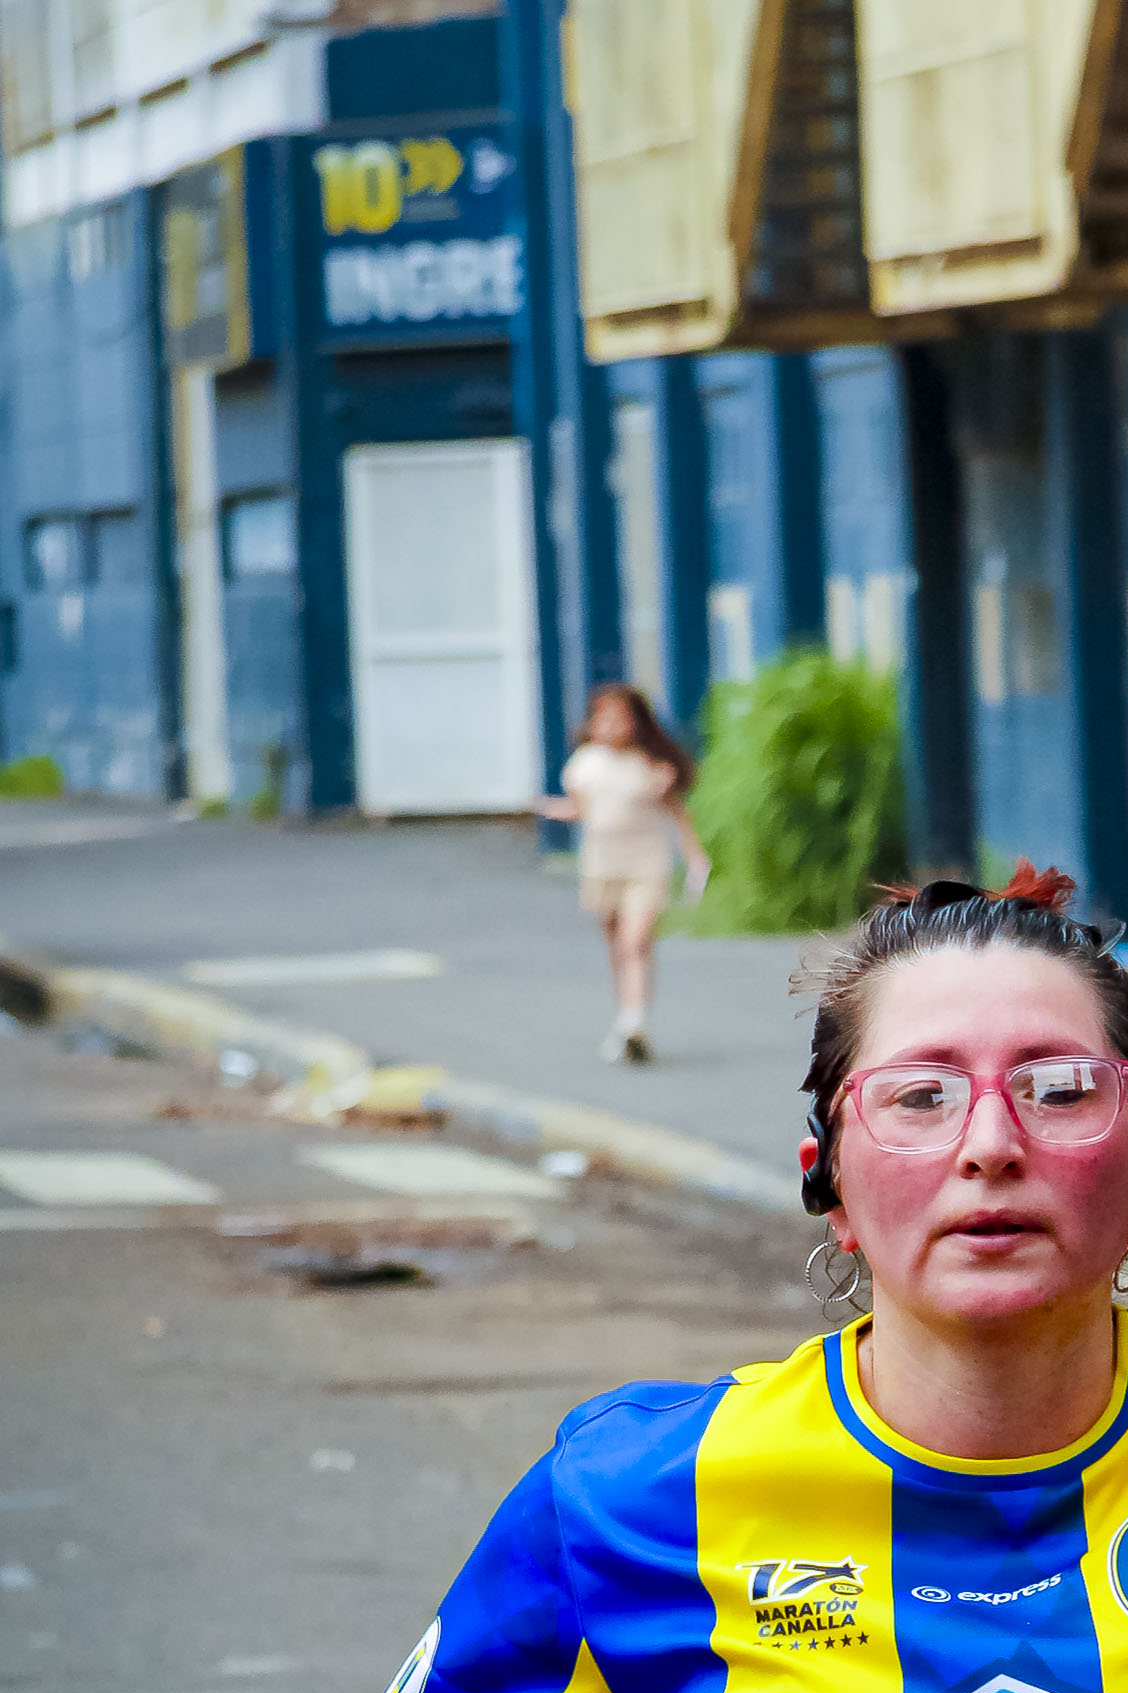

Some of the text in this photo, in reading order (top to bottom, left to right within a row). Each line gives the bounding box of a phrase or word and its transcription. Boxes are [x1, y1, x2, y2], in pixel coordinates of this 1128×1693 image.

[313, 140, 402, 235] 10
[957, 1573, 1063, 1605] express
[755, 1597, 858, 1623] MARATÓN
[758, 1613, 856, 1637] CANALLA
